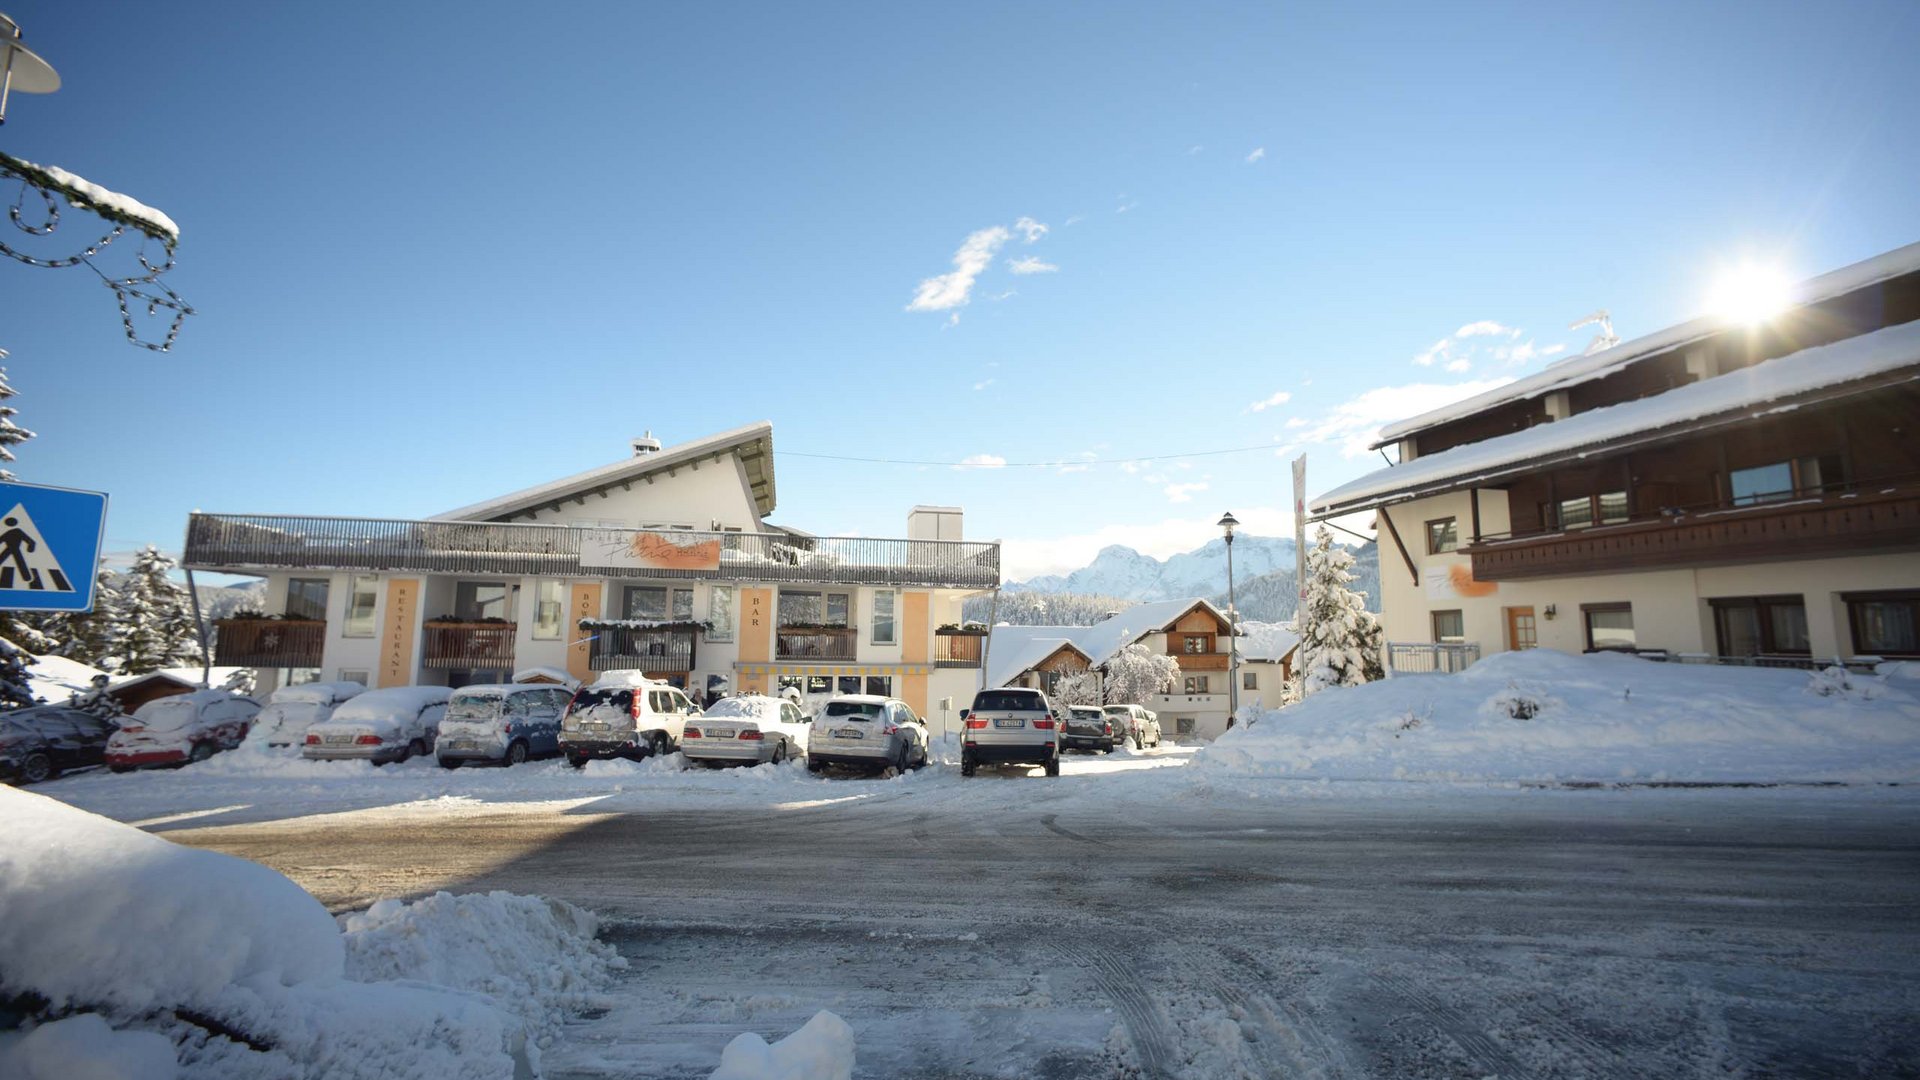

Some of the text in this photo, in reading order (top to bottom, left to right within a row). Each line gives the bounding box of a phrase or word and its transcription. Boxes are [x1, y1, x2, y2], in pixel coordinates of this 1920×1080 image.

[392, 588, 406, 677] RESTAURANT
[579, 593, 590, 652] BOWG
[752, 597, 760, 626] BAR
